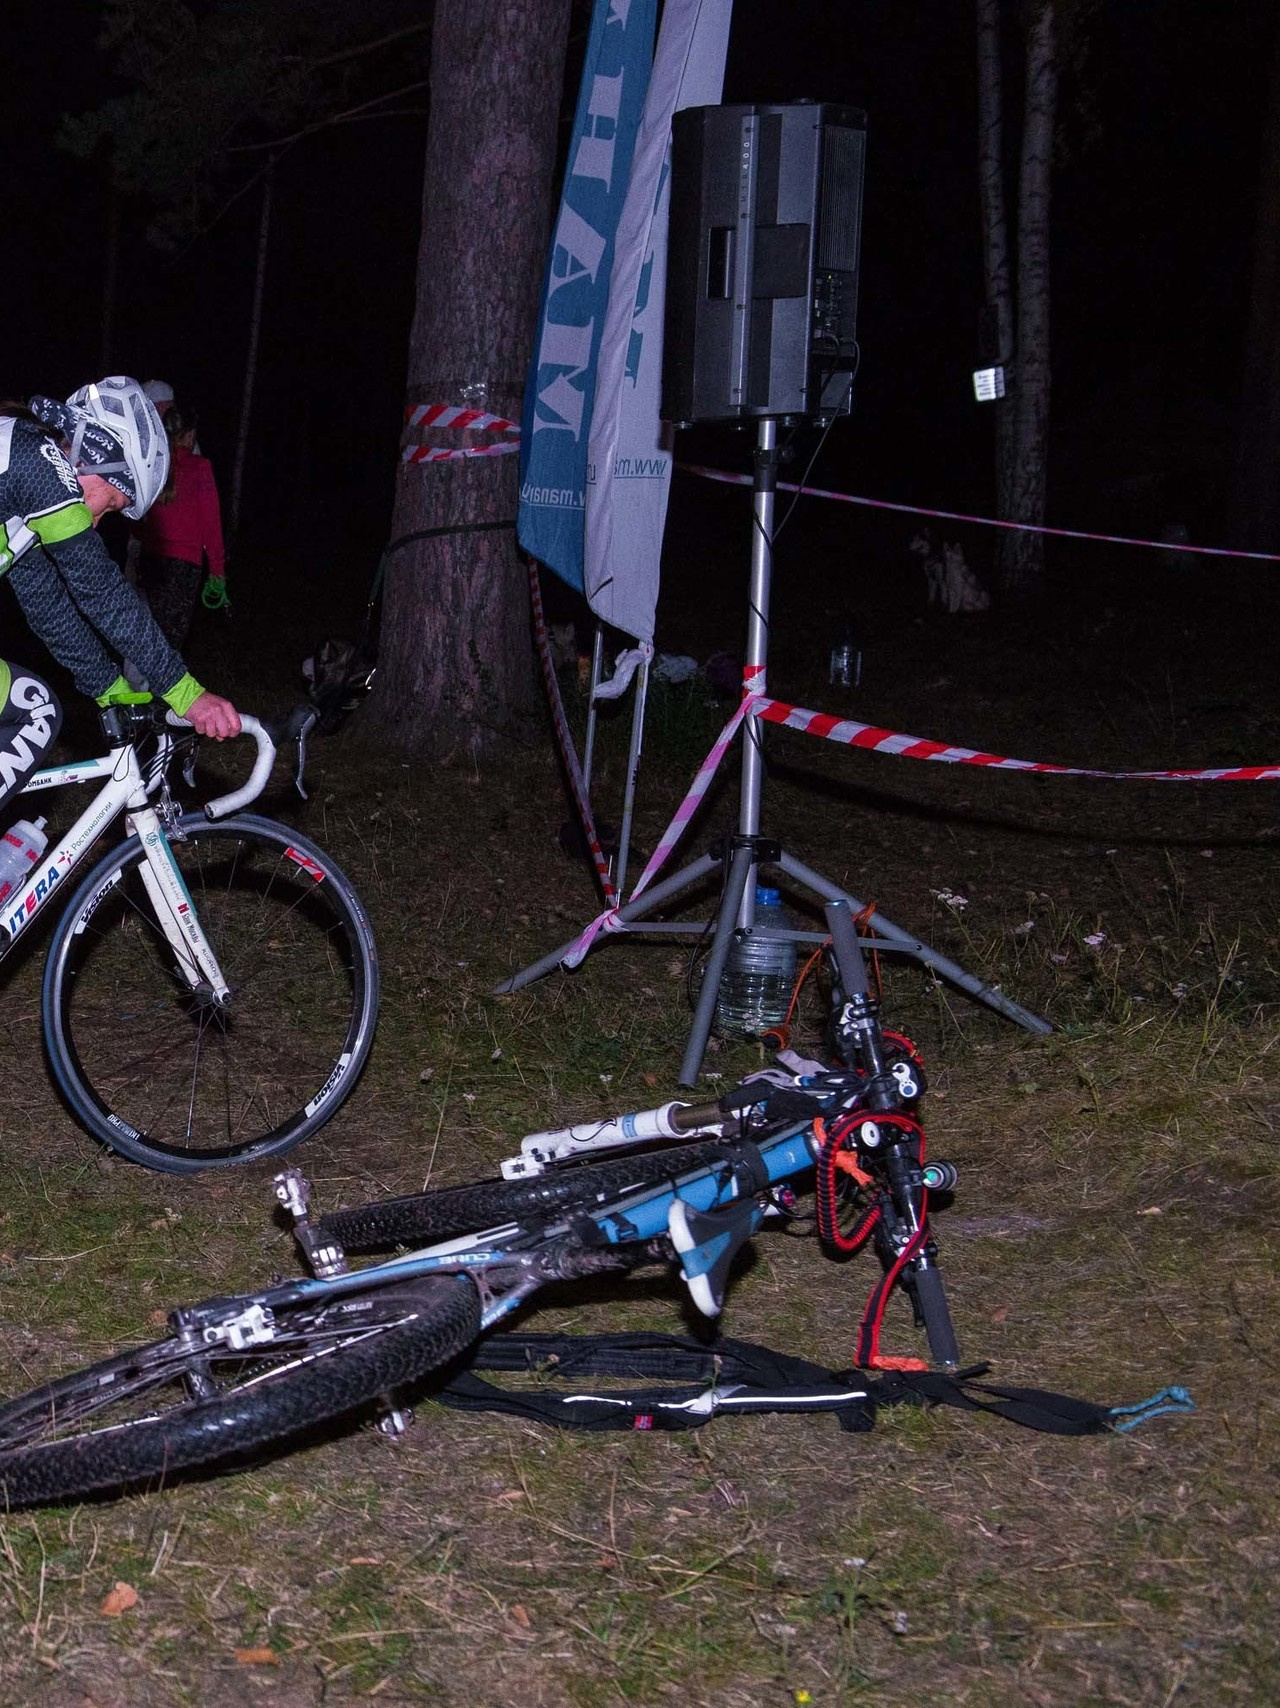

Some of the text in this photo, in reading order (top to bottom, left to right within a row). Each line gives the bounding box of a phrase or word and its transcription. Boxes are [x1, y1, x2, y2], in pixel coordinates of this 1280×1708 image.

[71, 801, 114, 851] Ростехнологии
[80, 879, 114, 923] Vision
[313, 1064, 345, 1106] Vision
